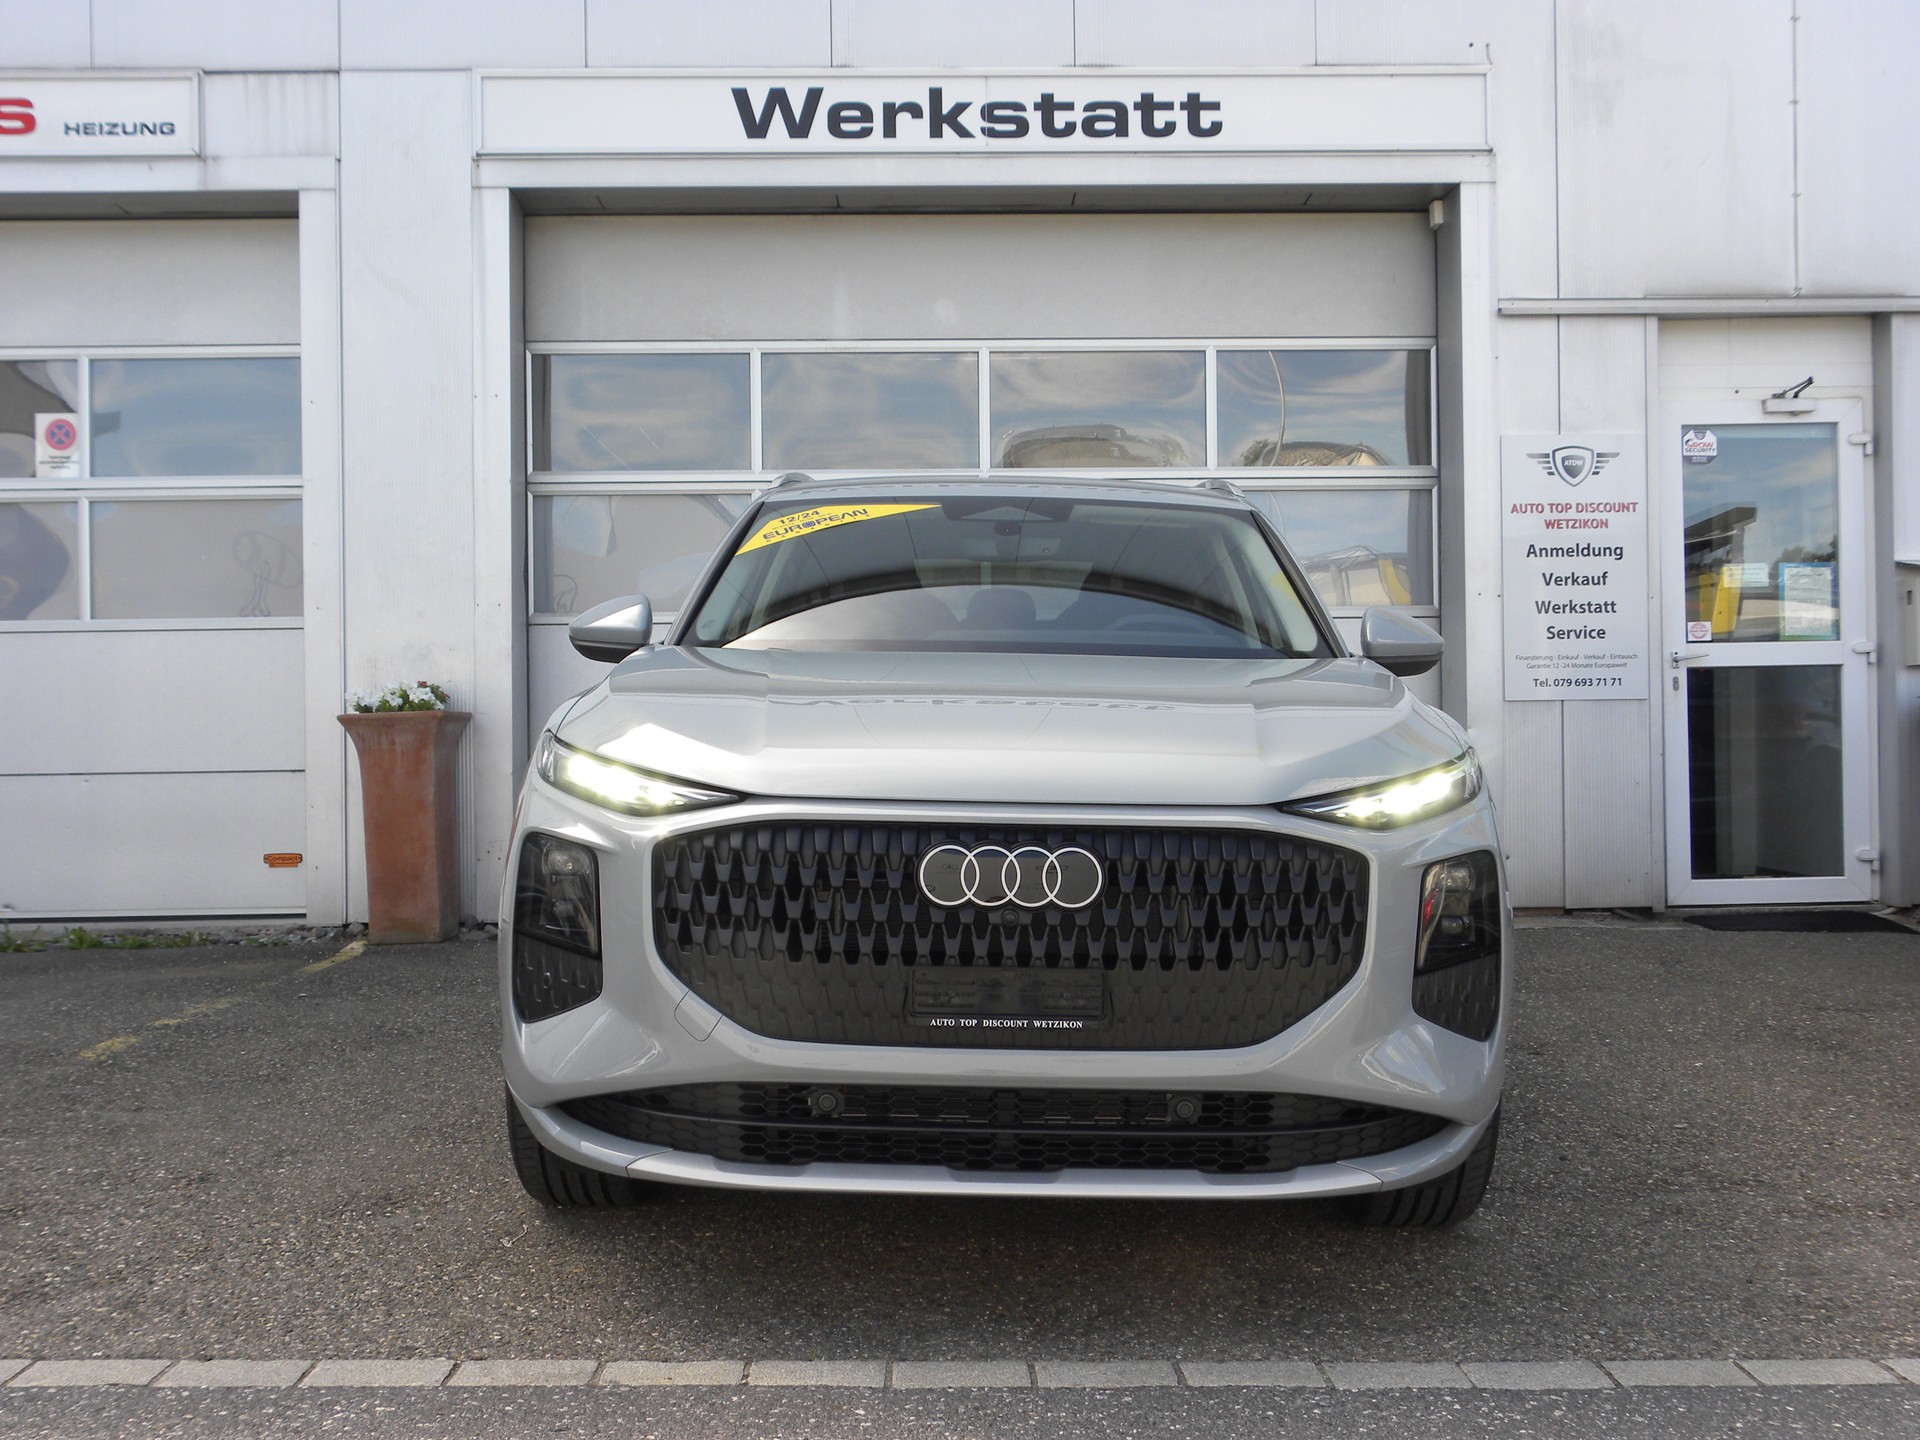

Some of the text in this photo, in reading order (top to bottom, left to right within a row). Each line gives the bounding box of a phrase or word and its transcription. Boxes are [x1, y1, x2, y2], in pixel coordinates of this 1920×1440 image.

[730, 86, 1224, 139] Werkstatt
[63, 122, 176, 136] HEIZUNG
[1510, 502, 1638, 514] AUTO TOP DISCOUNT
[762, 508, 868, 540] EUROPEAN
[778, 510, 821, 525] 12/24
[1544, 518, 1609, 530] WETZIKON
[1526, 542, 1624, 560] Anmeldung
[1542, 571, 1609, 586] Verkauf
[1535, 600, 1617, 614] Werkstatt
[1546, 625, 1606, 640] Service
[1533, 677, 1622, 687] Tel. 079 693 71 71
[267, 855, 298, 863] Compact
[930, 1018, 1083, 1029] AUTO TOP DISCOUNT WETZIKON
